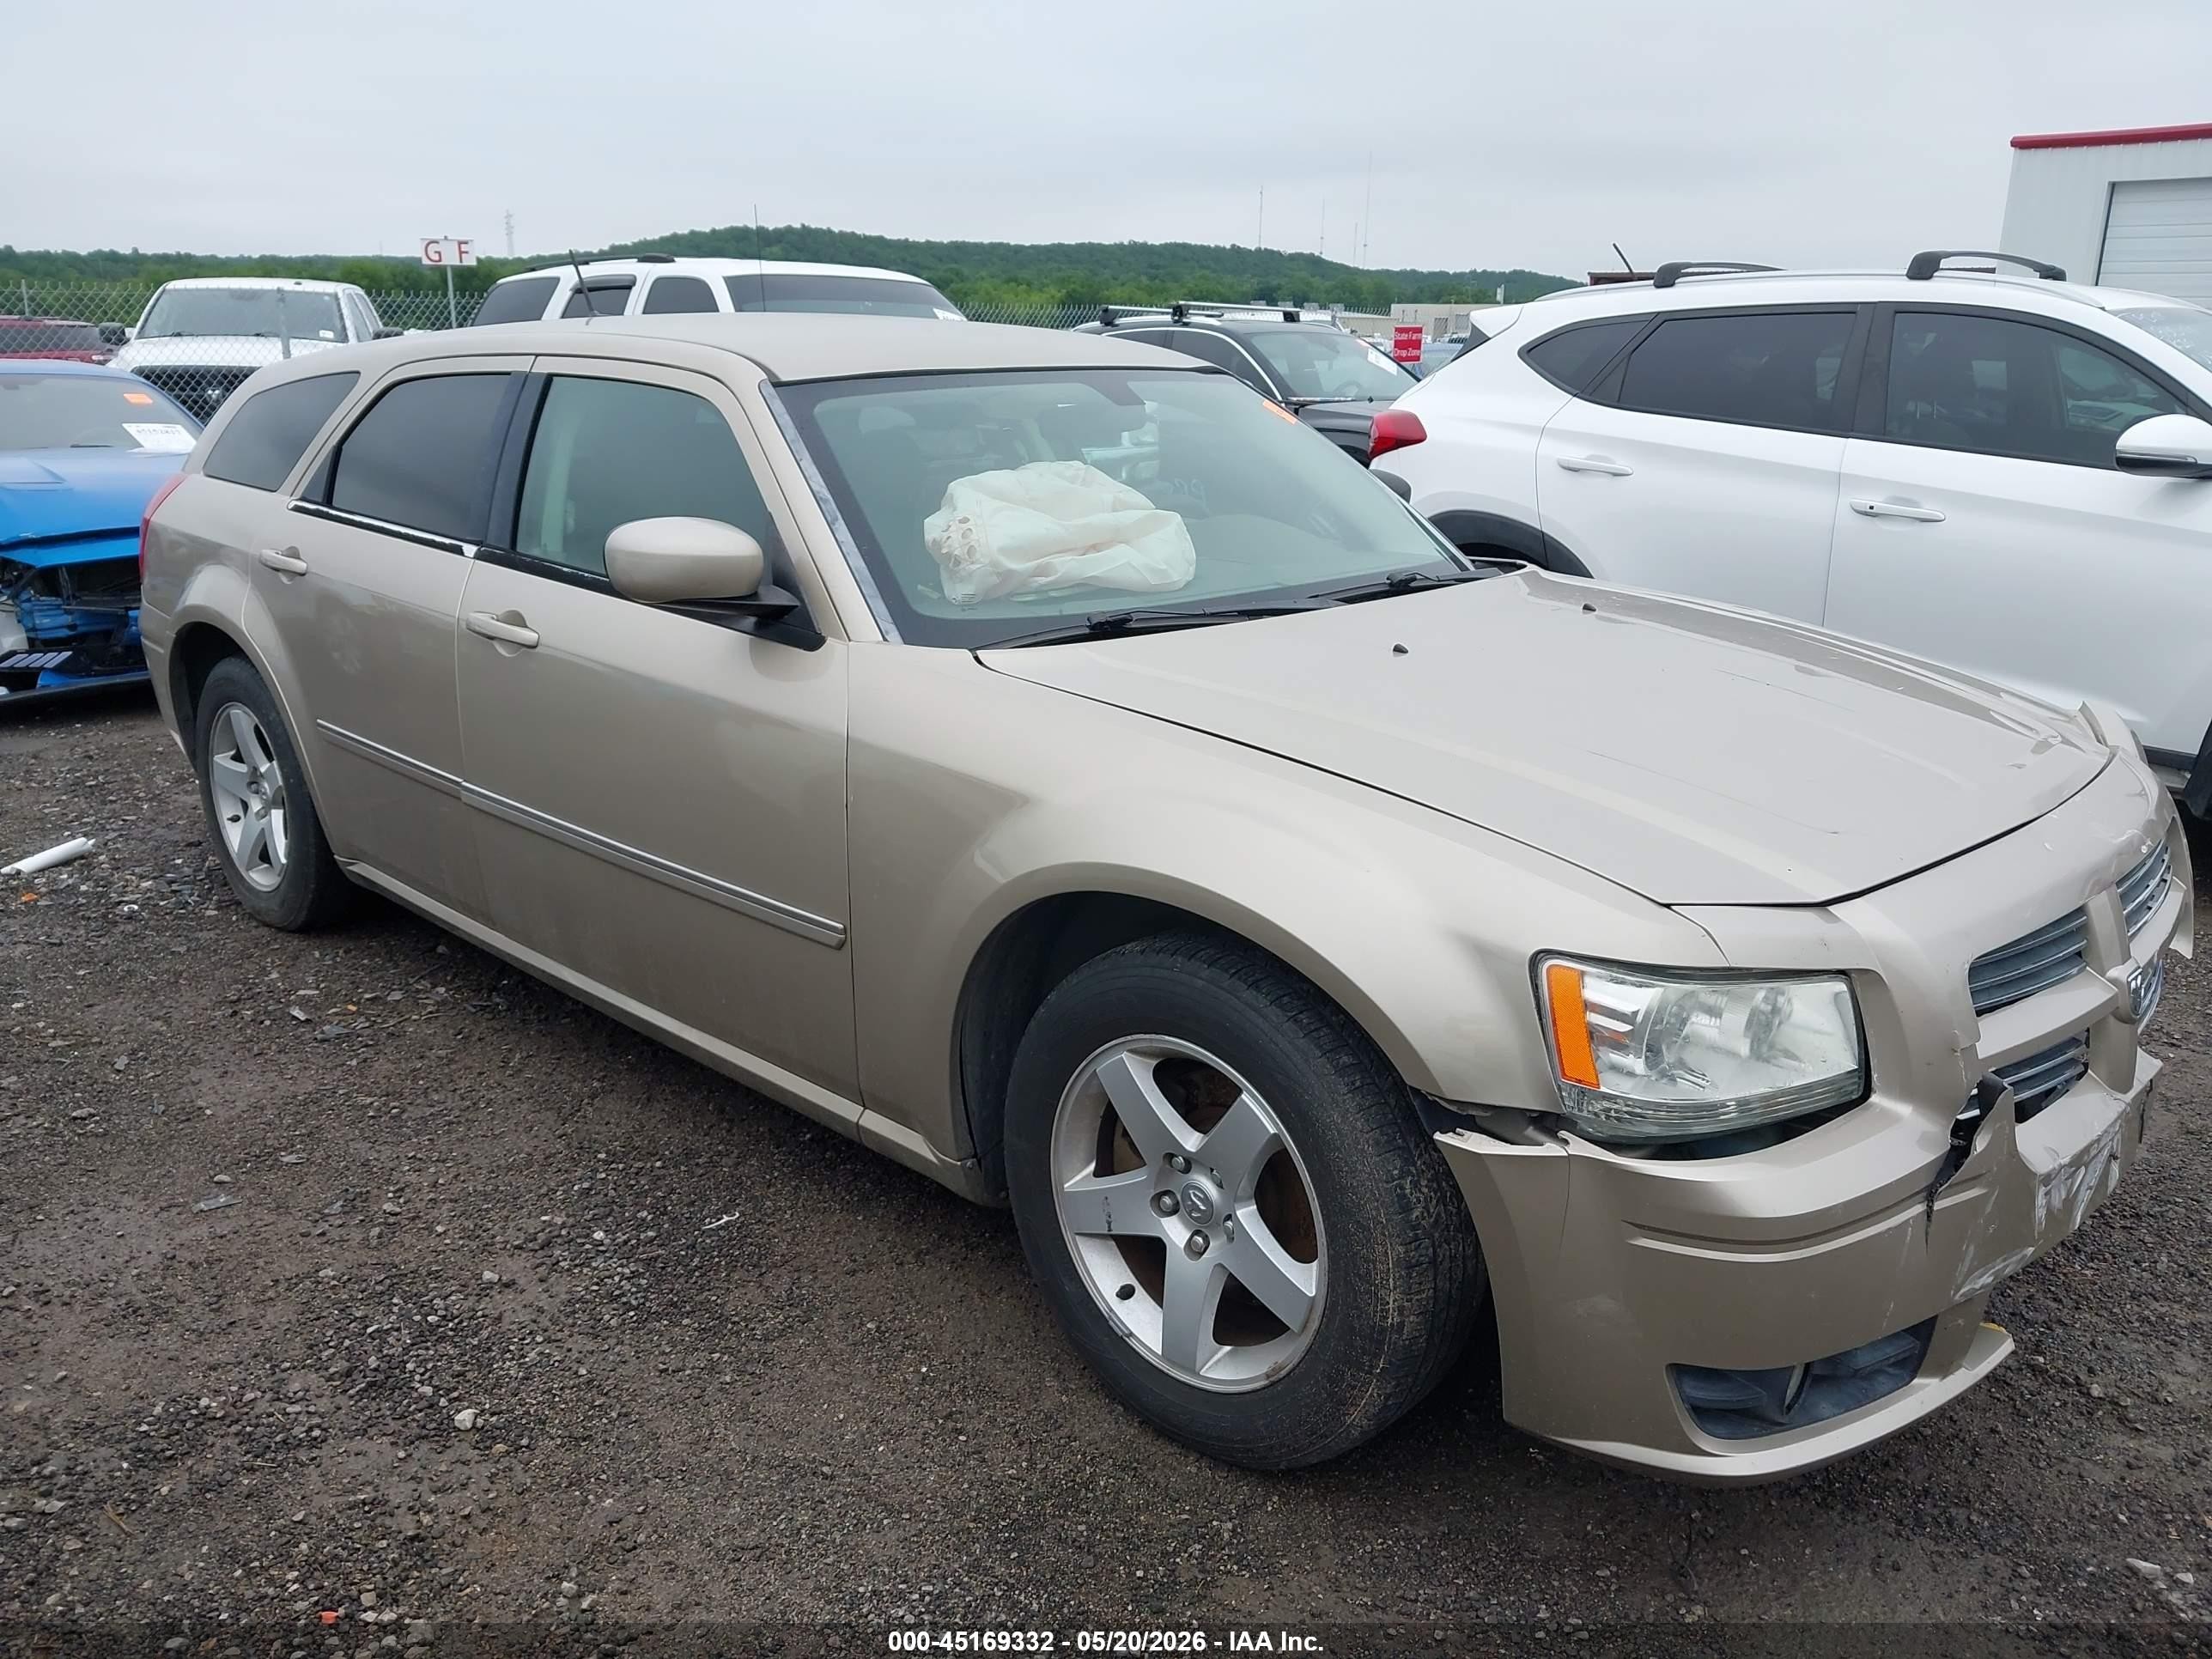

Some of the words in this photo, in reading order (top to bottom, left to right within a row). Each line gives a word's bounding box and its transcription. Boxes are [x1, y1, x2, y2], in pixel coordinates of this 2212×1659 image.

[424, 240, 442, 263] G
[458, 240, 469, 264] F
[1394, 348, 1407, 358] Drop
